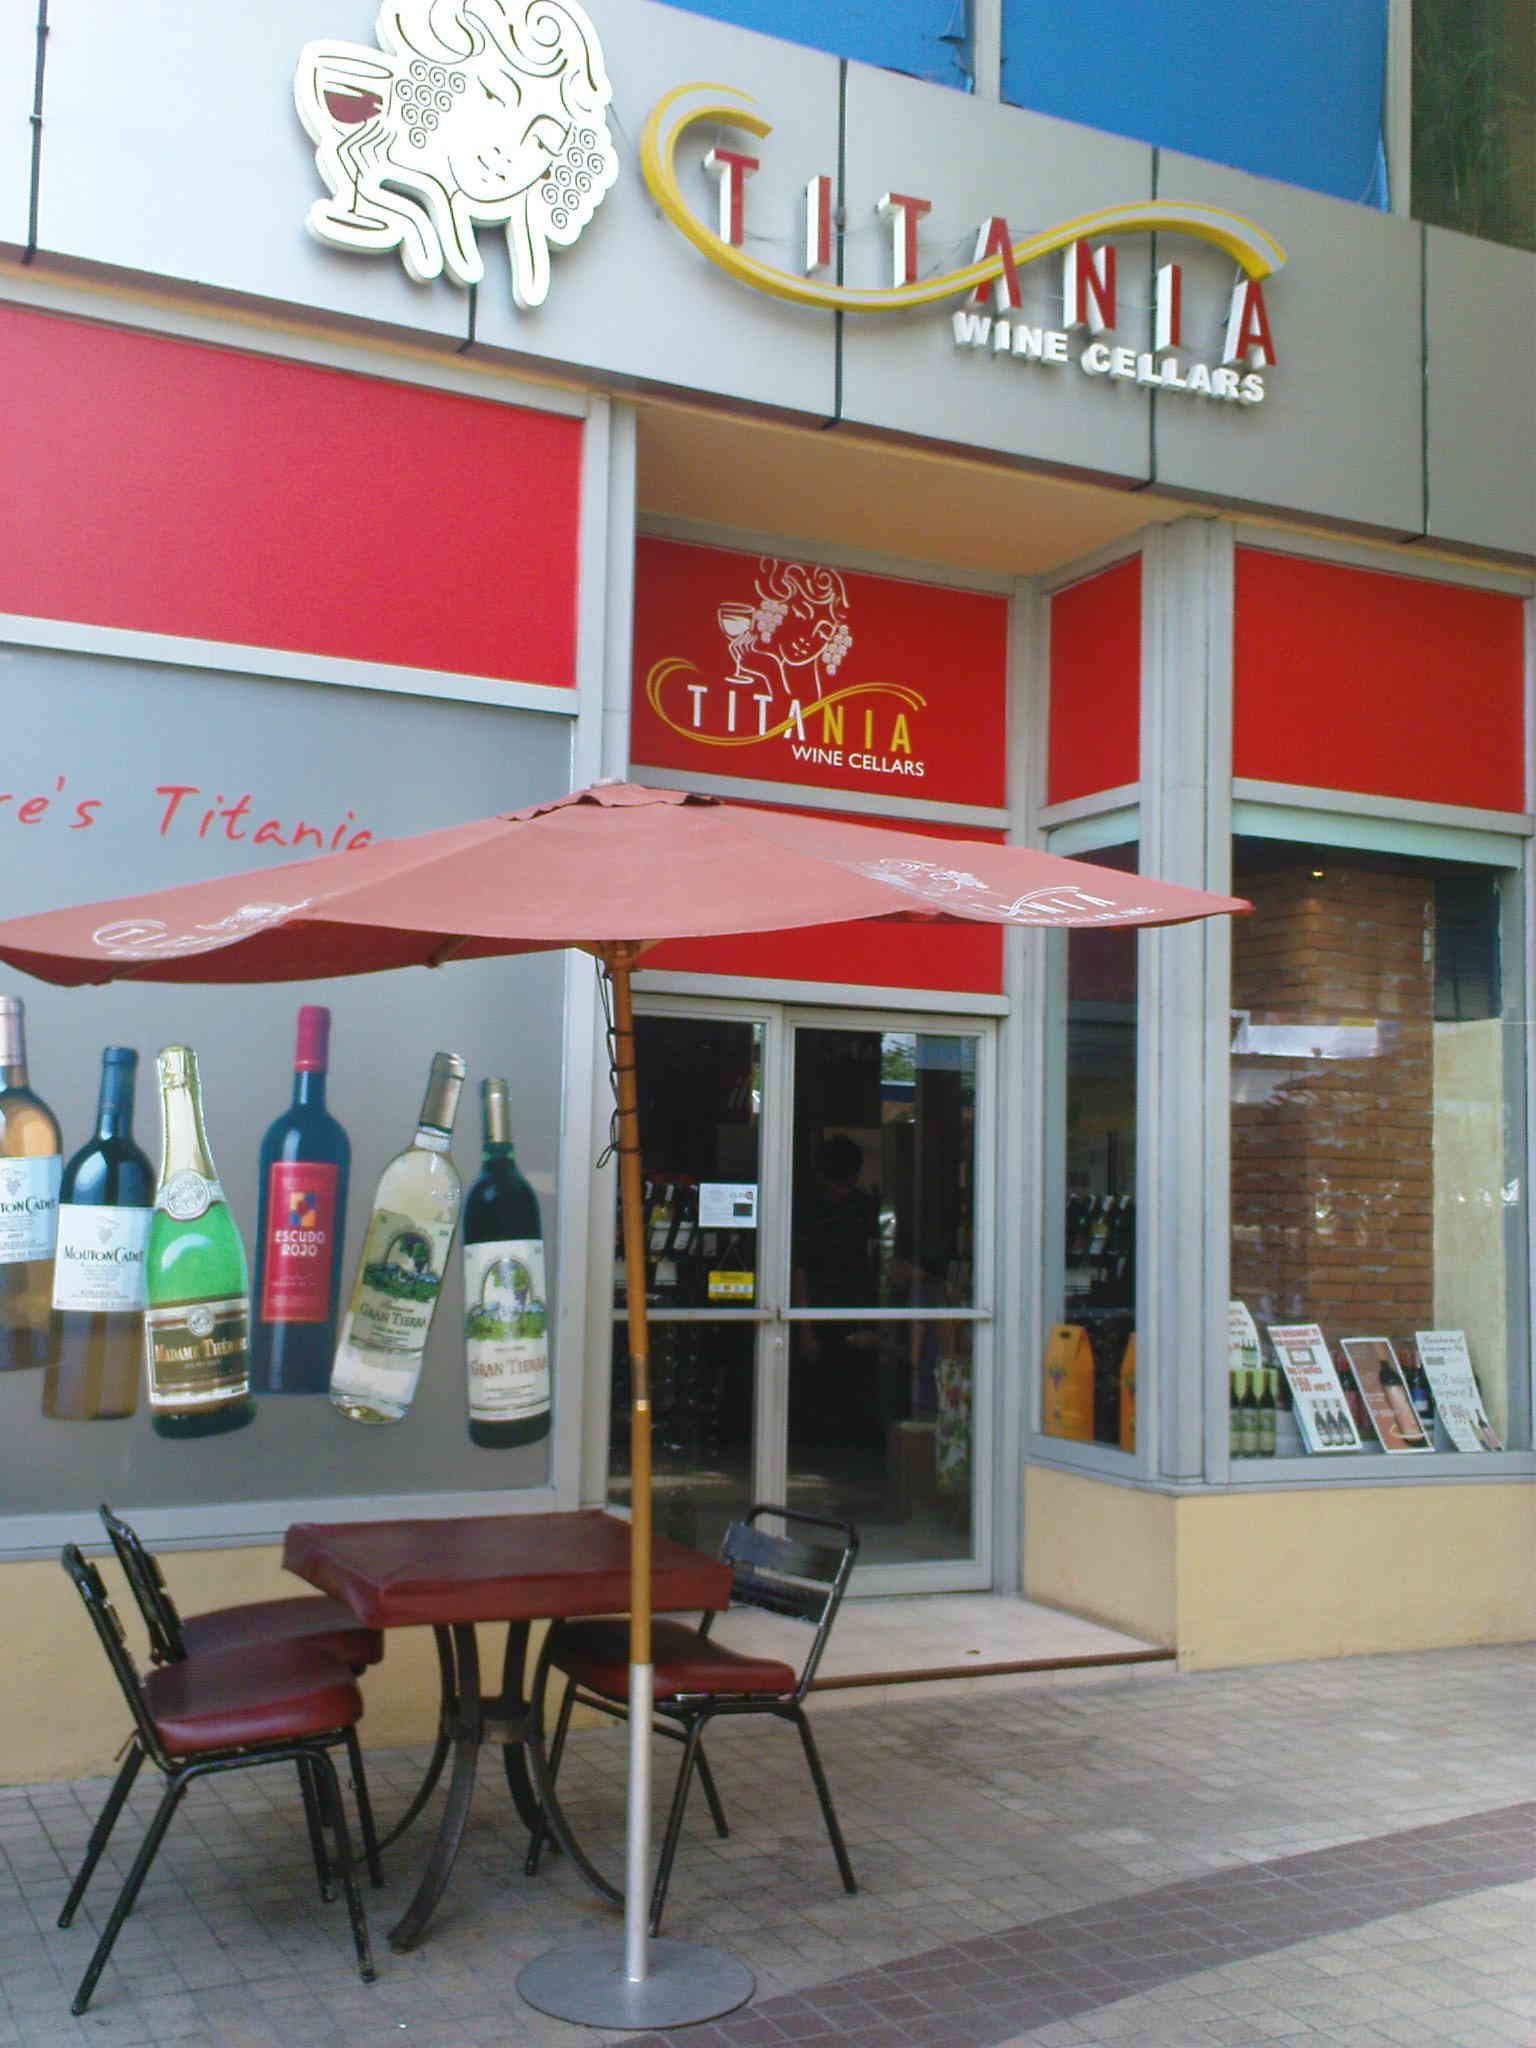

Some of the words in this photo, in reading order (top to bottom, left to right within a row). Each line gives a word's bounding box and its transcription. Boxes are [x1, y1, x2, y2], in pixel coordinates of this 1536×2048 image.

[703, 147, 1276, 370] TITANIA
[952, 311, 1069, 365] WINE
[1080, 342, 1266, 405] CELLARS
[687, 684, 913, 755] TITANIA
[791, 744, 844, 767] WINE
[848, 752, 926, 777] CELLARS
[155, 785, 375, 852] Titania
[275, 1229, 325, 1244] ESCUDO
